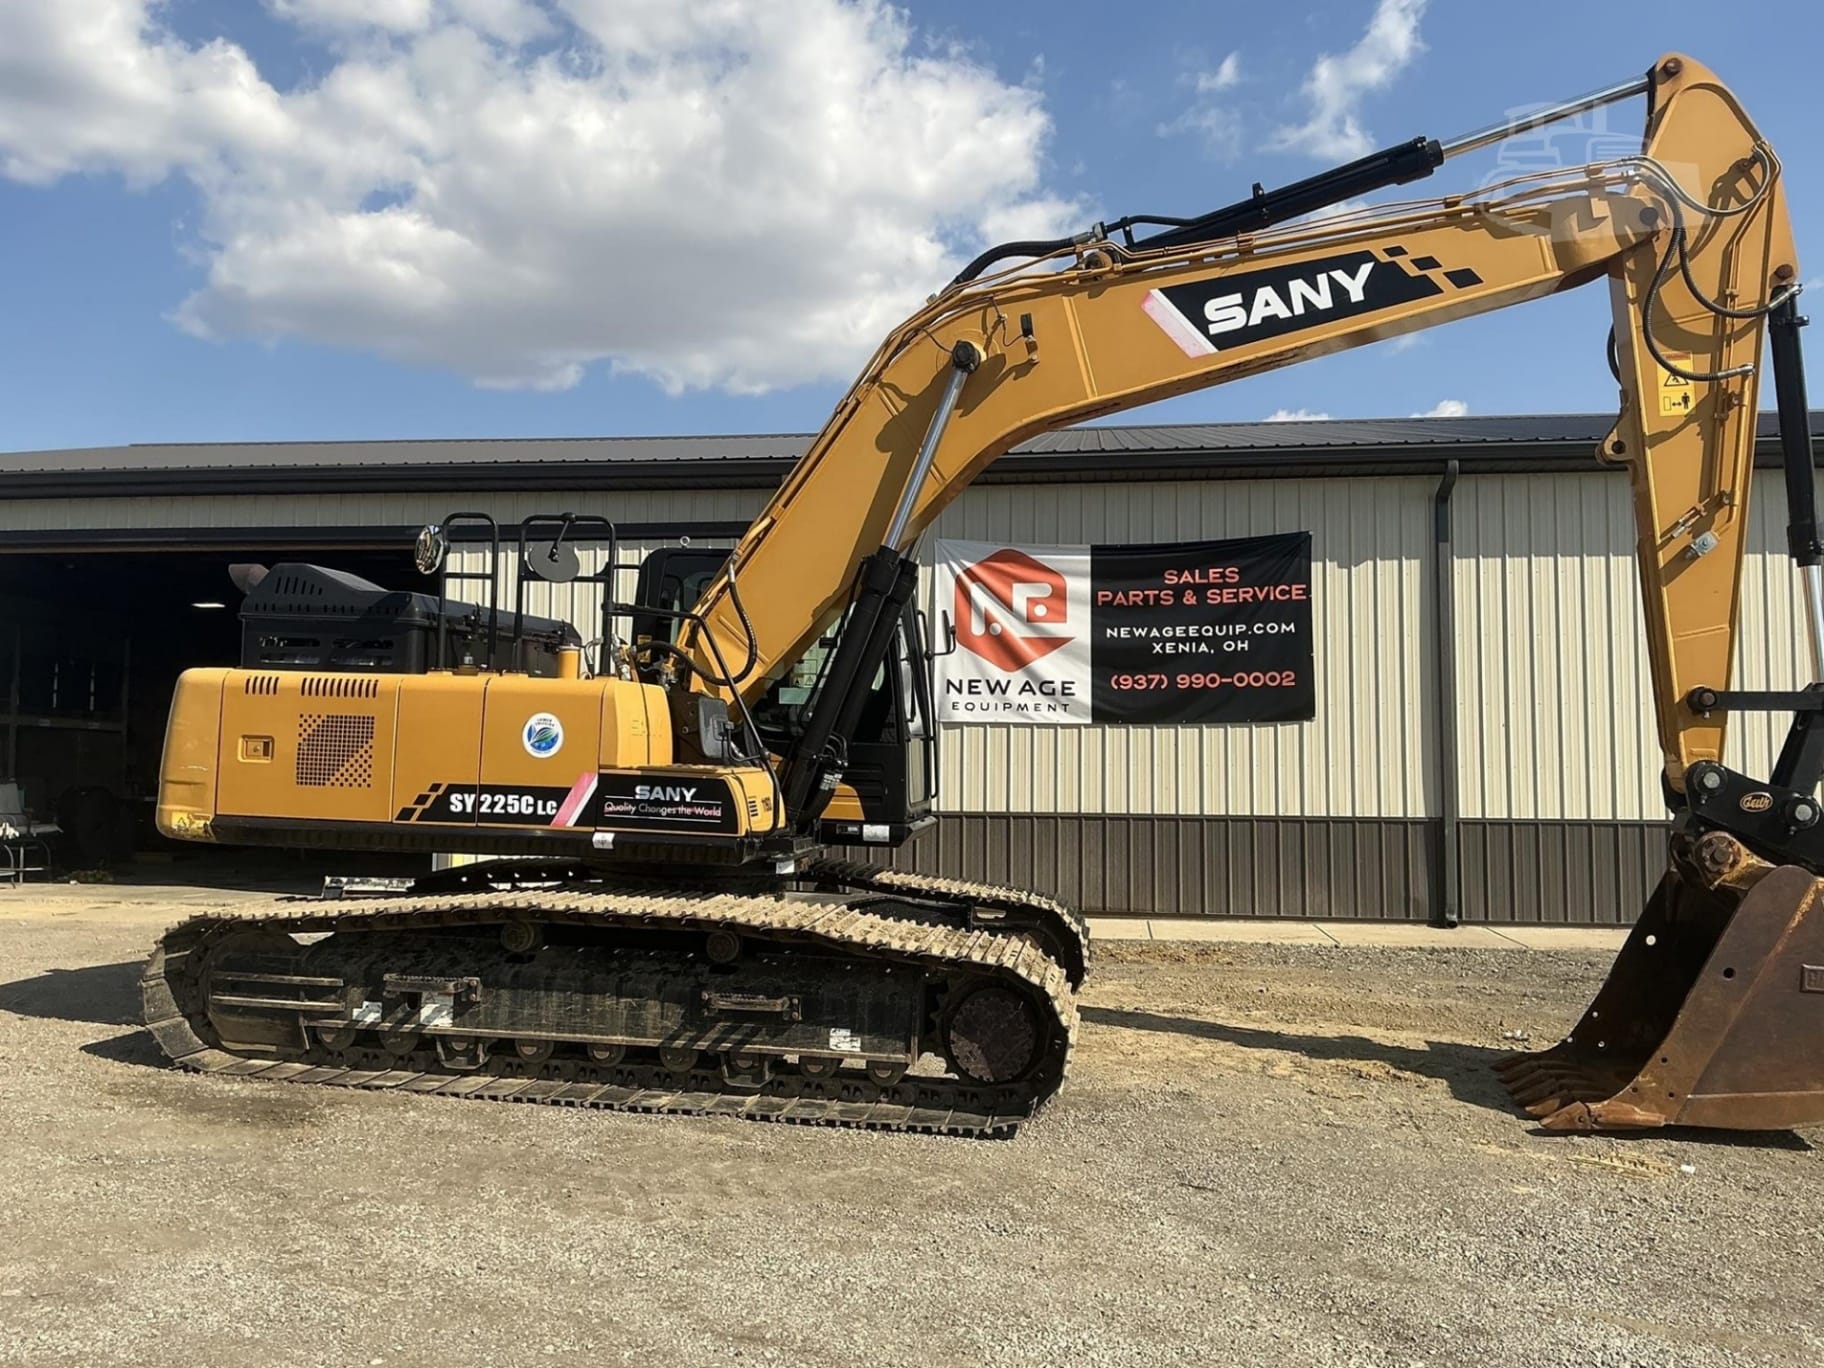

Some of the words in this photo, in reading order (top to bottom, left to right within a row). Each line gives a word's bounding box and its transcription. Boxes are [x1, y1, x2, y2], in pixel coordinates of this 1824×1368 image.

[1203, 261, 1375, 335] SANY
[1163, 567, 1240, 584] SALES
[1096, 589, 1174, 607] PARTS
[1182, 590, 1198, 605] &
[1205, 584, 1307, 603] SERVICE
[1106, 621, 1296, 638] NEWAGEEQUIP.COM
[1151, 642, 1215, 655] XENIA,
[1222, 640, 1249, 653] OH
[945, 678, 1013, 697] NEW
[1017, 680, 1077, 697] AGE
[1110, 673, 1169, 691] (937)
[1176, 671, 1296, 689] 990-0002
[951, 701, 1071, 713] EQUIPMENT
[634, 785, 697, 802] SANY
[604, 802, 637, 814] Quality
[638, 803, 677, 816] Changes
[677, 806, 691, 815] the
[694, 807, 722, 817] World
